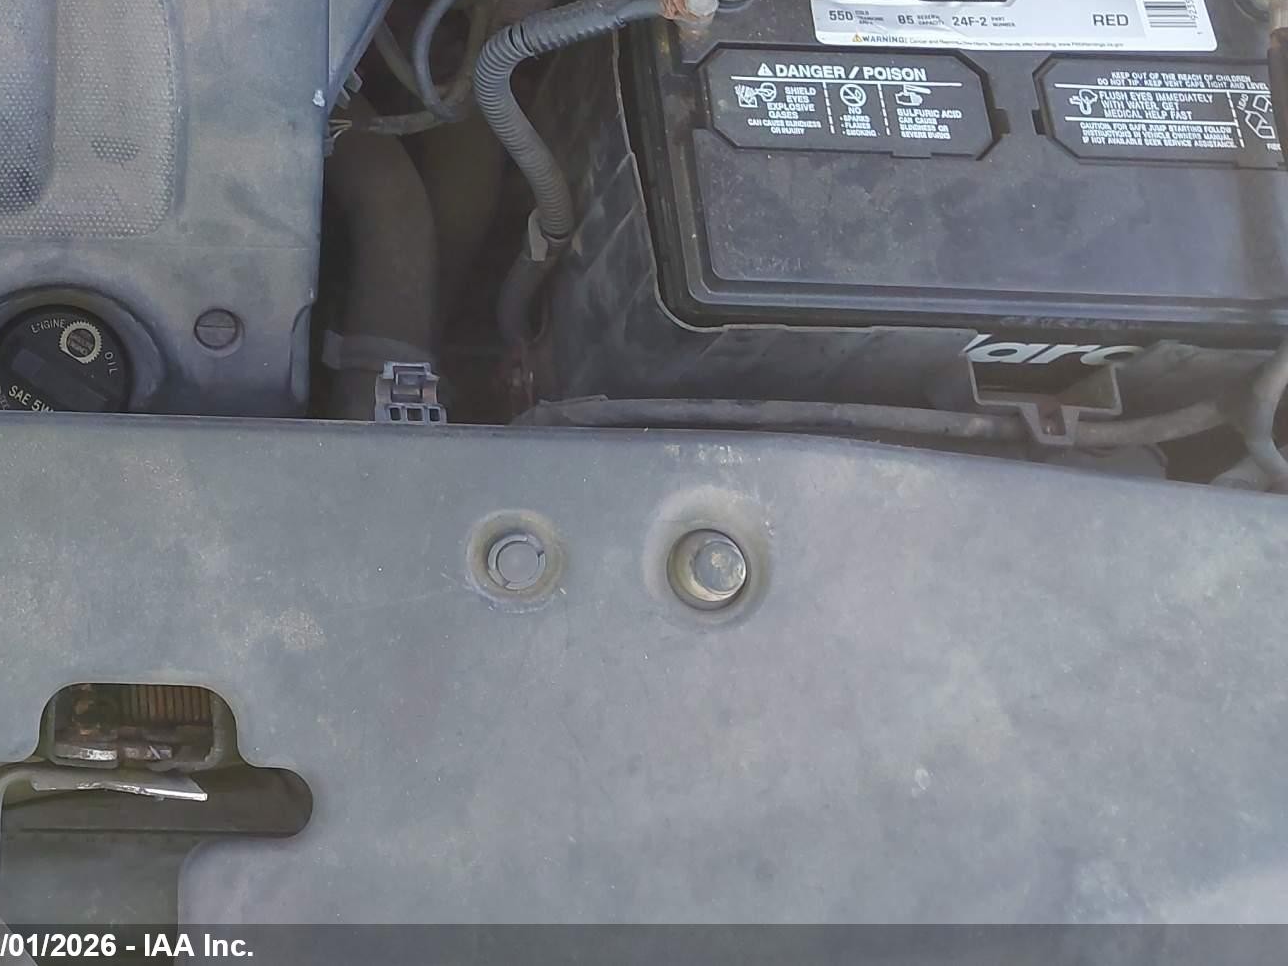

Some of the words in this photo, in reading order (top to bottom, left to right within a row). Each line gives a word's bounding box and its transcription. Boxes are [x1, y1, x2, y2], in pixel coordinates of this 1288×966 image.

[828, 10, 854, 22] 550
[898, 14, 915, 26] 85
[951, 16, 988, 28] 24F-2
[1092, 14, 1129, 27] RED
[775, 64, 846, 80] DANGER
[863, 67, 927, 81] POISON
[1111, 71, 1130, 80] KEEP
[1131, 72, 1147, 81] OUT
[1149, 72, 1160, 81] OF
[1161, 73, 1176, 82] THE
[1177, 73, 1203, 82] REACH
[1203, 74, 1214, 83] OF
[1215, 75, 1252, 83] CHILDREN
[1097, 77, 1109, 86] DO
[1109, 78, 1126, 87] NOT
[1144, 79, 1163, 88] KEEP
[1164, 80, 1183, 89] VENT
[1184, 81, 1206, 89] CAPS
[1207, 81, 1228, 90] TIGHT
[1230, 81, 1245, 90] AND
[784, 86, 817, 96] SHIELD
[1098, 90, 1128, 102] FLUSH
[1129, 91, 1154, 103] EYES
[1155, 92, 1213, 104] IMMEDIATELY
[786, 95, 810, 104] EYES
[767, 102, 816, 112] EXPLOSIVE
[848, 106, 862, 115] NO
[1100, 100, 1125, 110] WITH
[1161, 102, 1180, 112] GET
[768, 111, 799, 120] GASES
[896, 108, 940, 119] SULFURIC
[941, 109, 962, 120] ACID
[1104, 109, 1144, 119] MEDICAL
[1144, 110, 1169, 121] HELP
[1169, 111, 1193, 121] FAST
[1112, 122, 1128, 131] FOR
[1168, 124, 1203, 133] STARTING
[1203, 125, 1232, 134] FOLLOW
[1089, 136, 1106, 145] NOT
[30, 318, 66, 334] ENGINE
[104, 351, 118, 378] OIL
[8, 385, 32, 407] SAE
